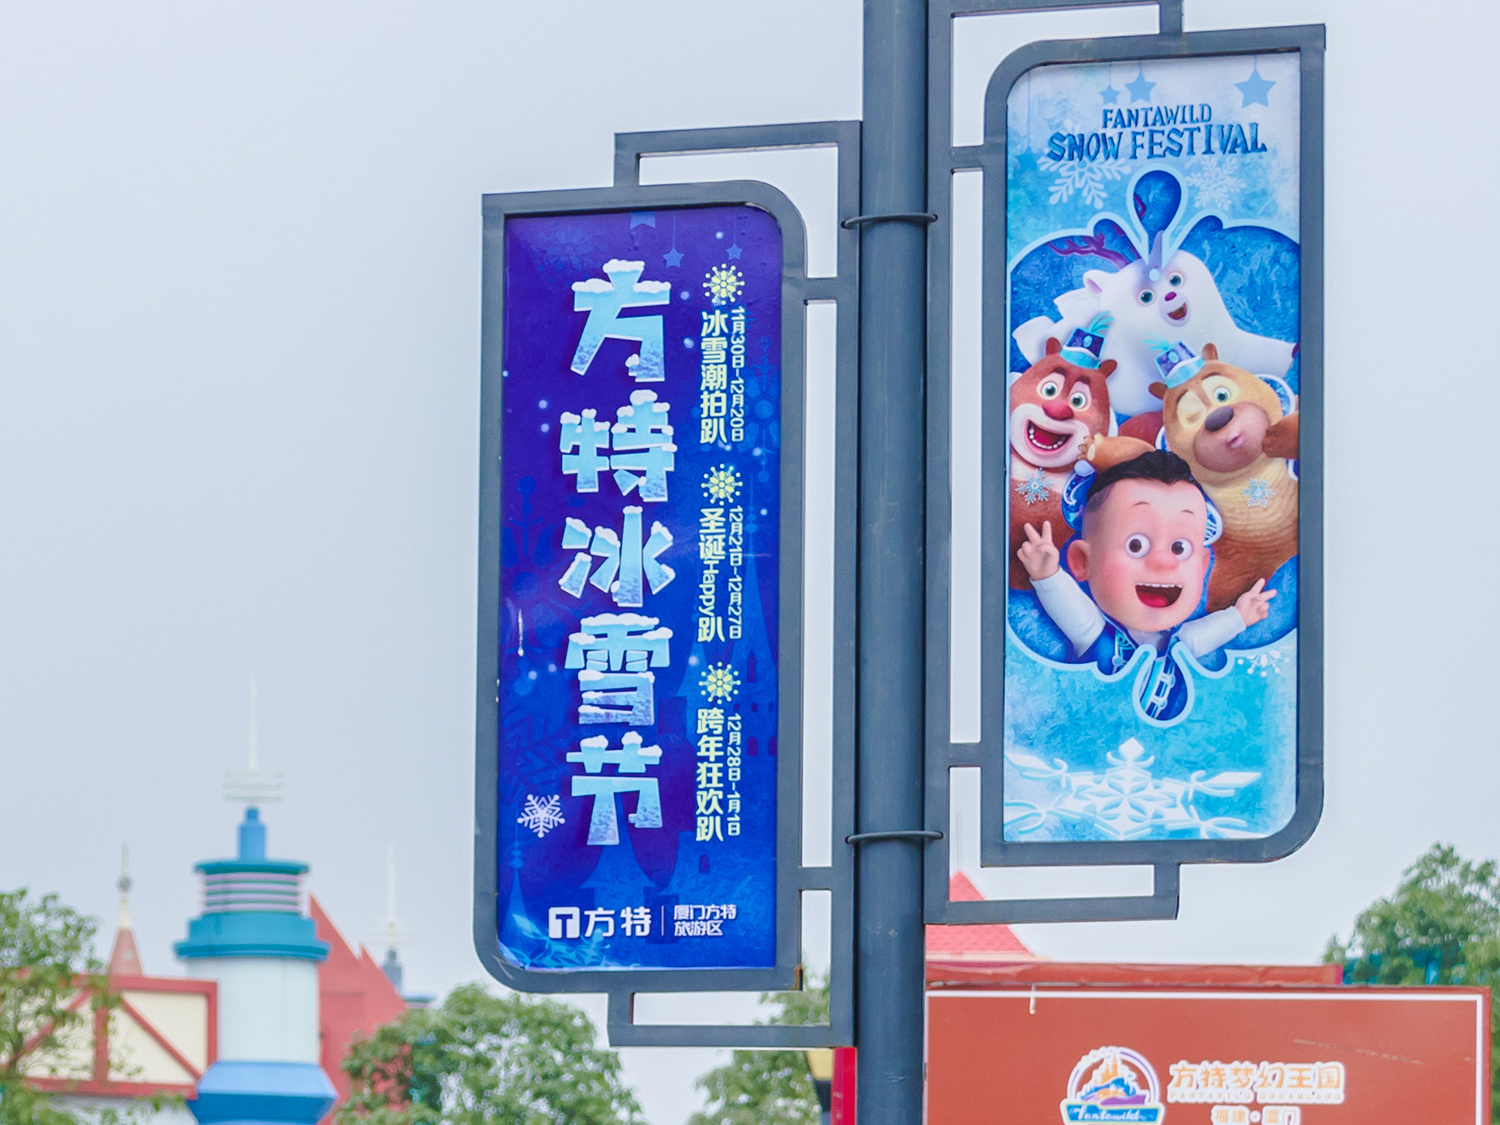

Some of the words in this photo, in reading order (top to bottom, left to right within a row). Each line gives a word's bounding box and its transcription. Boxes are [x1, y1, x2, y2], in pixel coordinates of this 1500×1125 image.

[1046, 130, 1125, 162] SNOW
[1128, 121, 1268, 161] FESTIVAL
[1101, 103, 1213, 129] FANTAWILD
[699, 309, 729, 445] 冰雪潮拍趴
[729, 305, 746, 443] 11月30日-12月20日
[558, 258, 678, 846] 方特冰雪节
[697, 507, 727, 643] 圣诞Happy趴
[727, 504, 744, 640] 12月21日-12月27日
[695, 707, 725, 842] 跨年狂欢趴
[726, 713, 742, 837] 12月28日-1月1日
[583, 906, 652, 938] 方特
[673, 903, 737, 921] 厦门方特
[673, 919, 724, 937] 旅游区
[1170, 1062, 1343, 1091] 方特梦幻王国
